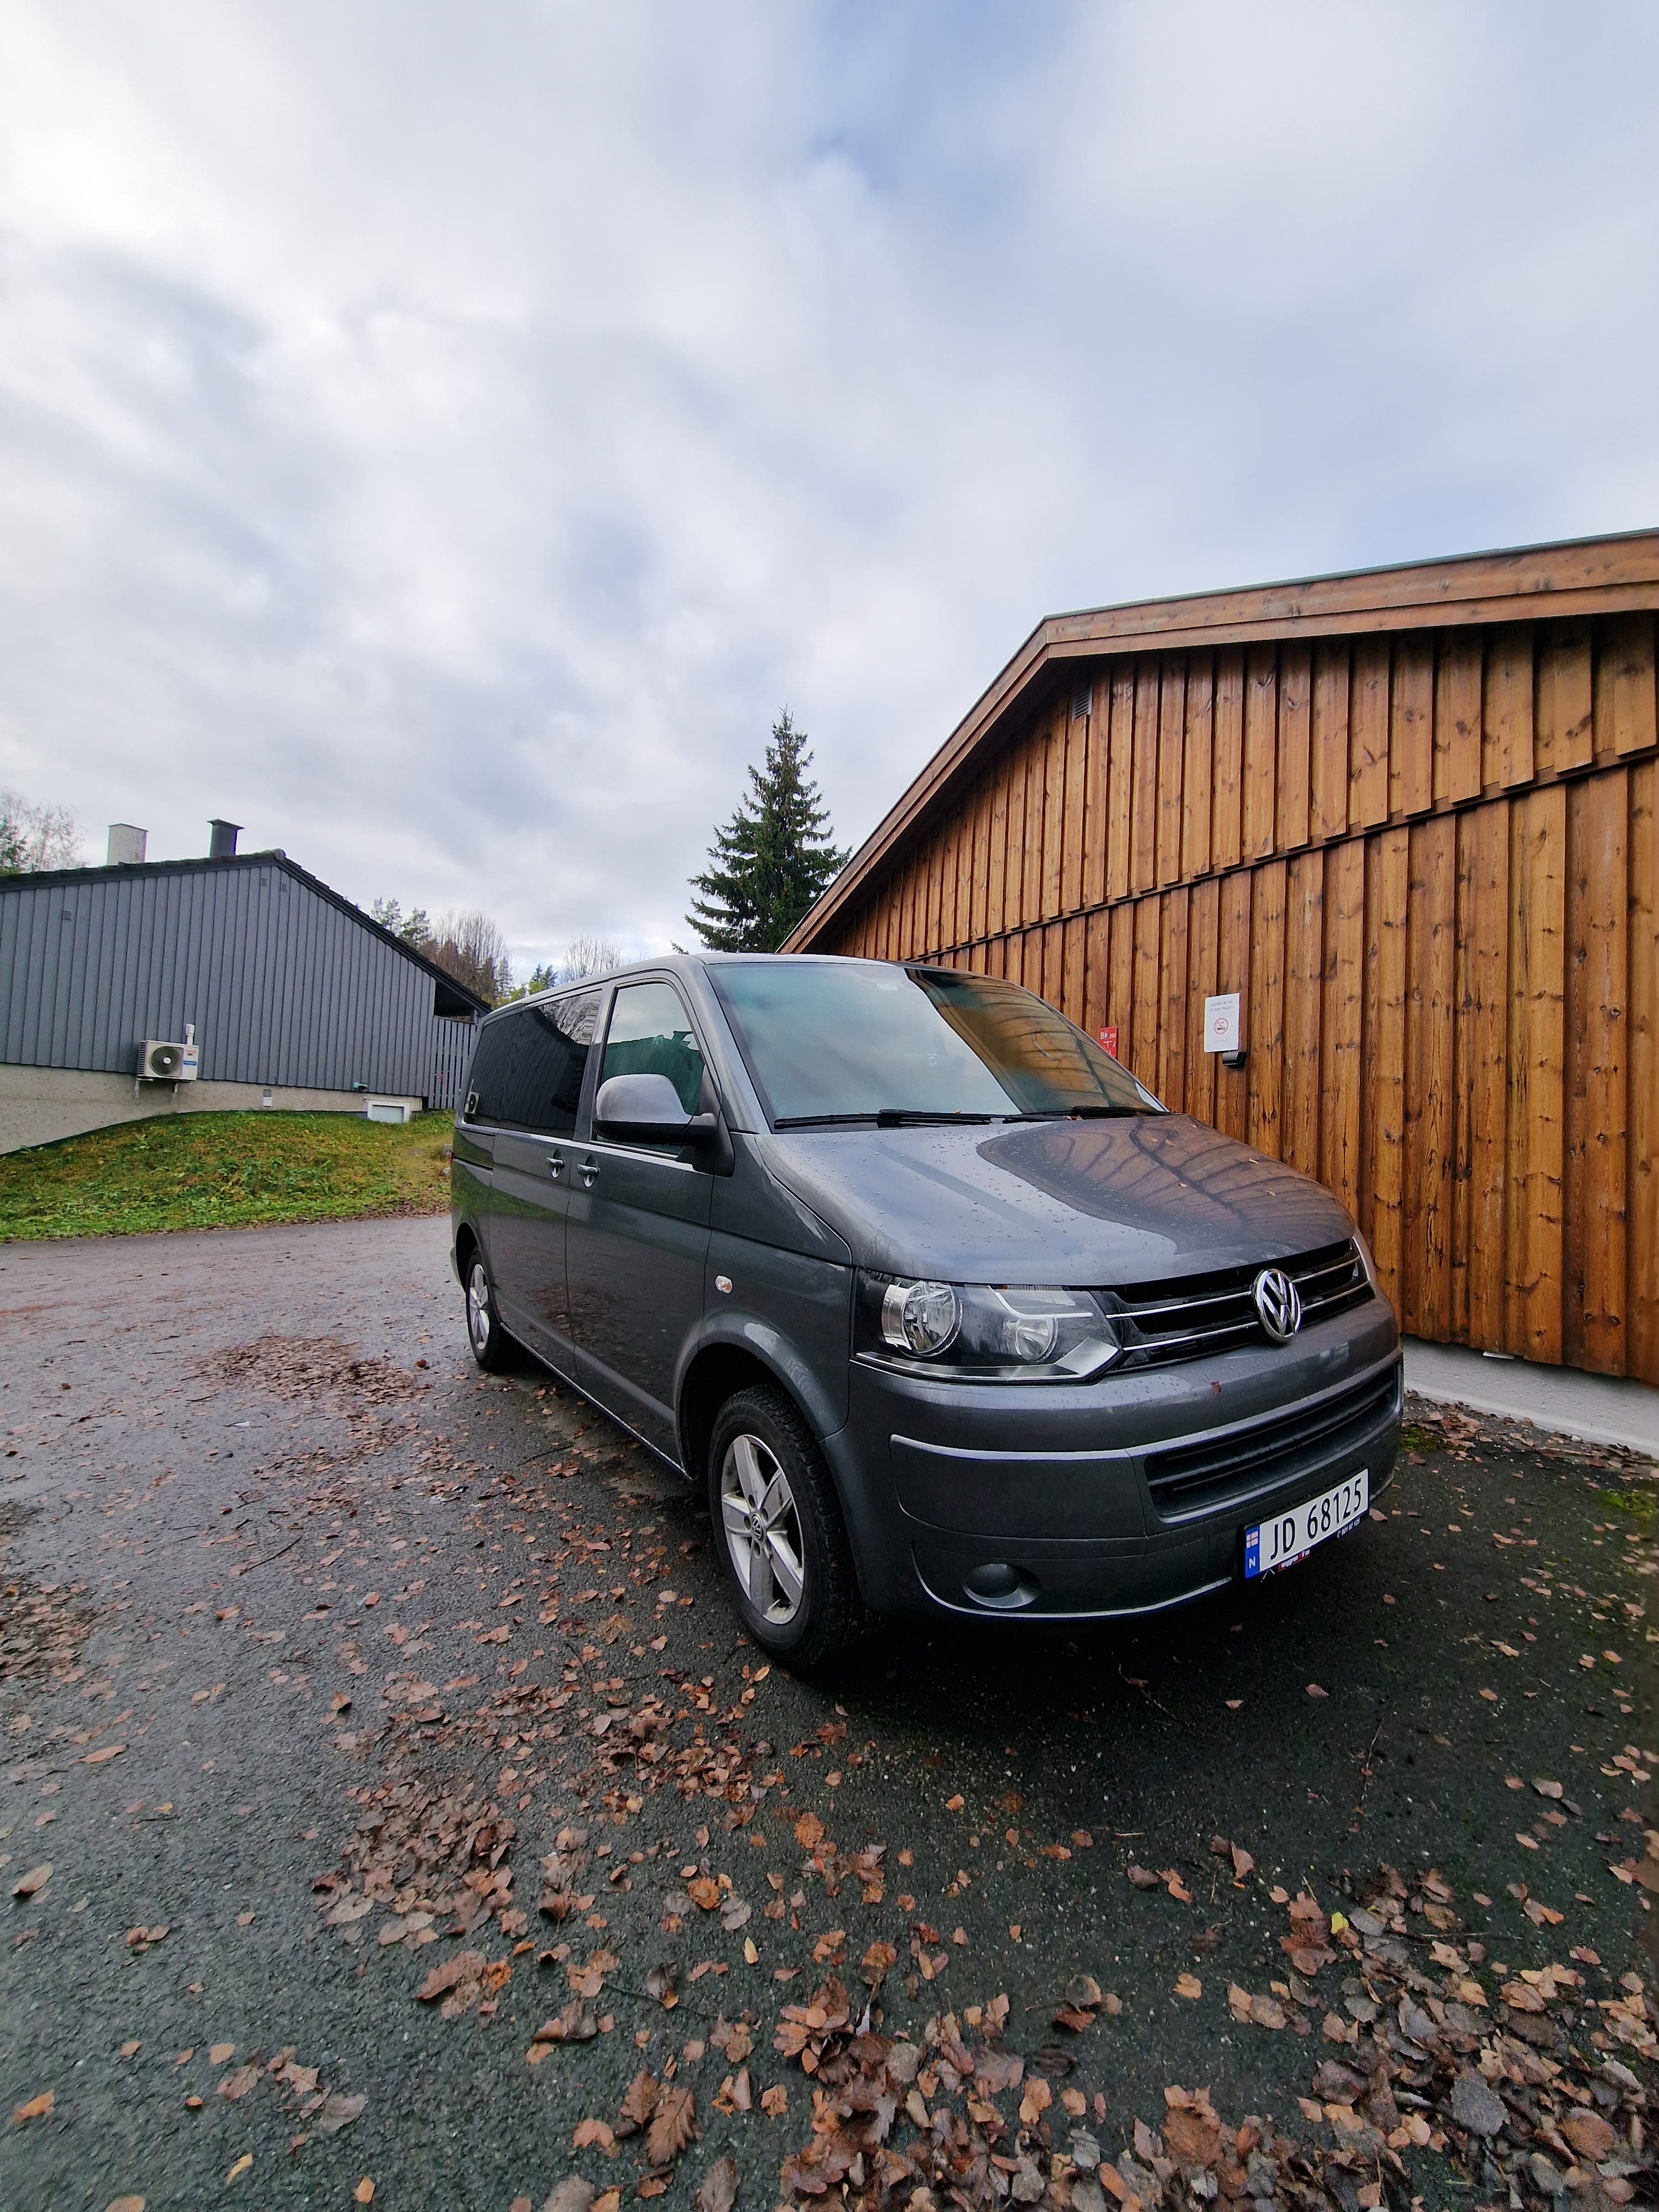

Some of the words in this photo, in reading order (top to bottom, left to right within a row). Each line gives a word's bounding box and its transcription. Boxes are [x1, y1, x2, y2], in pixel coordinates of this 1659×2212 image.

[1270, 1517, 1296, 1561] JD
[1307, 1477, 1362, 1540] 68125
[1248, 1558, 1256, 1569] N
